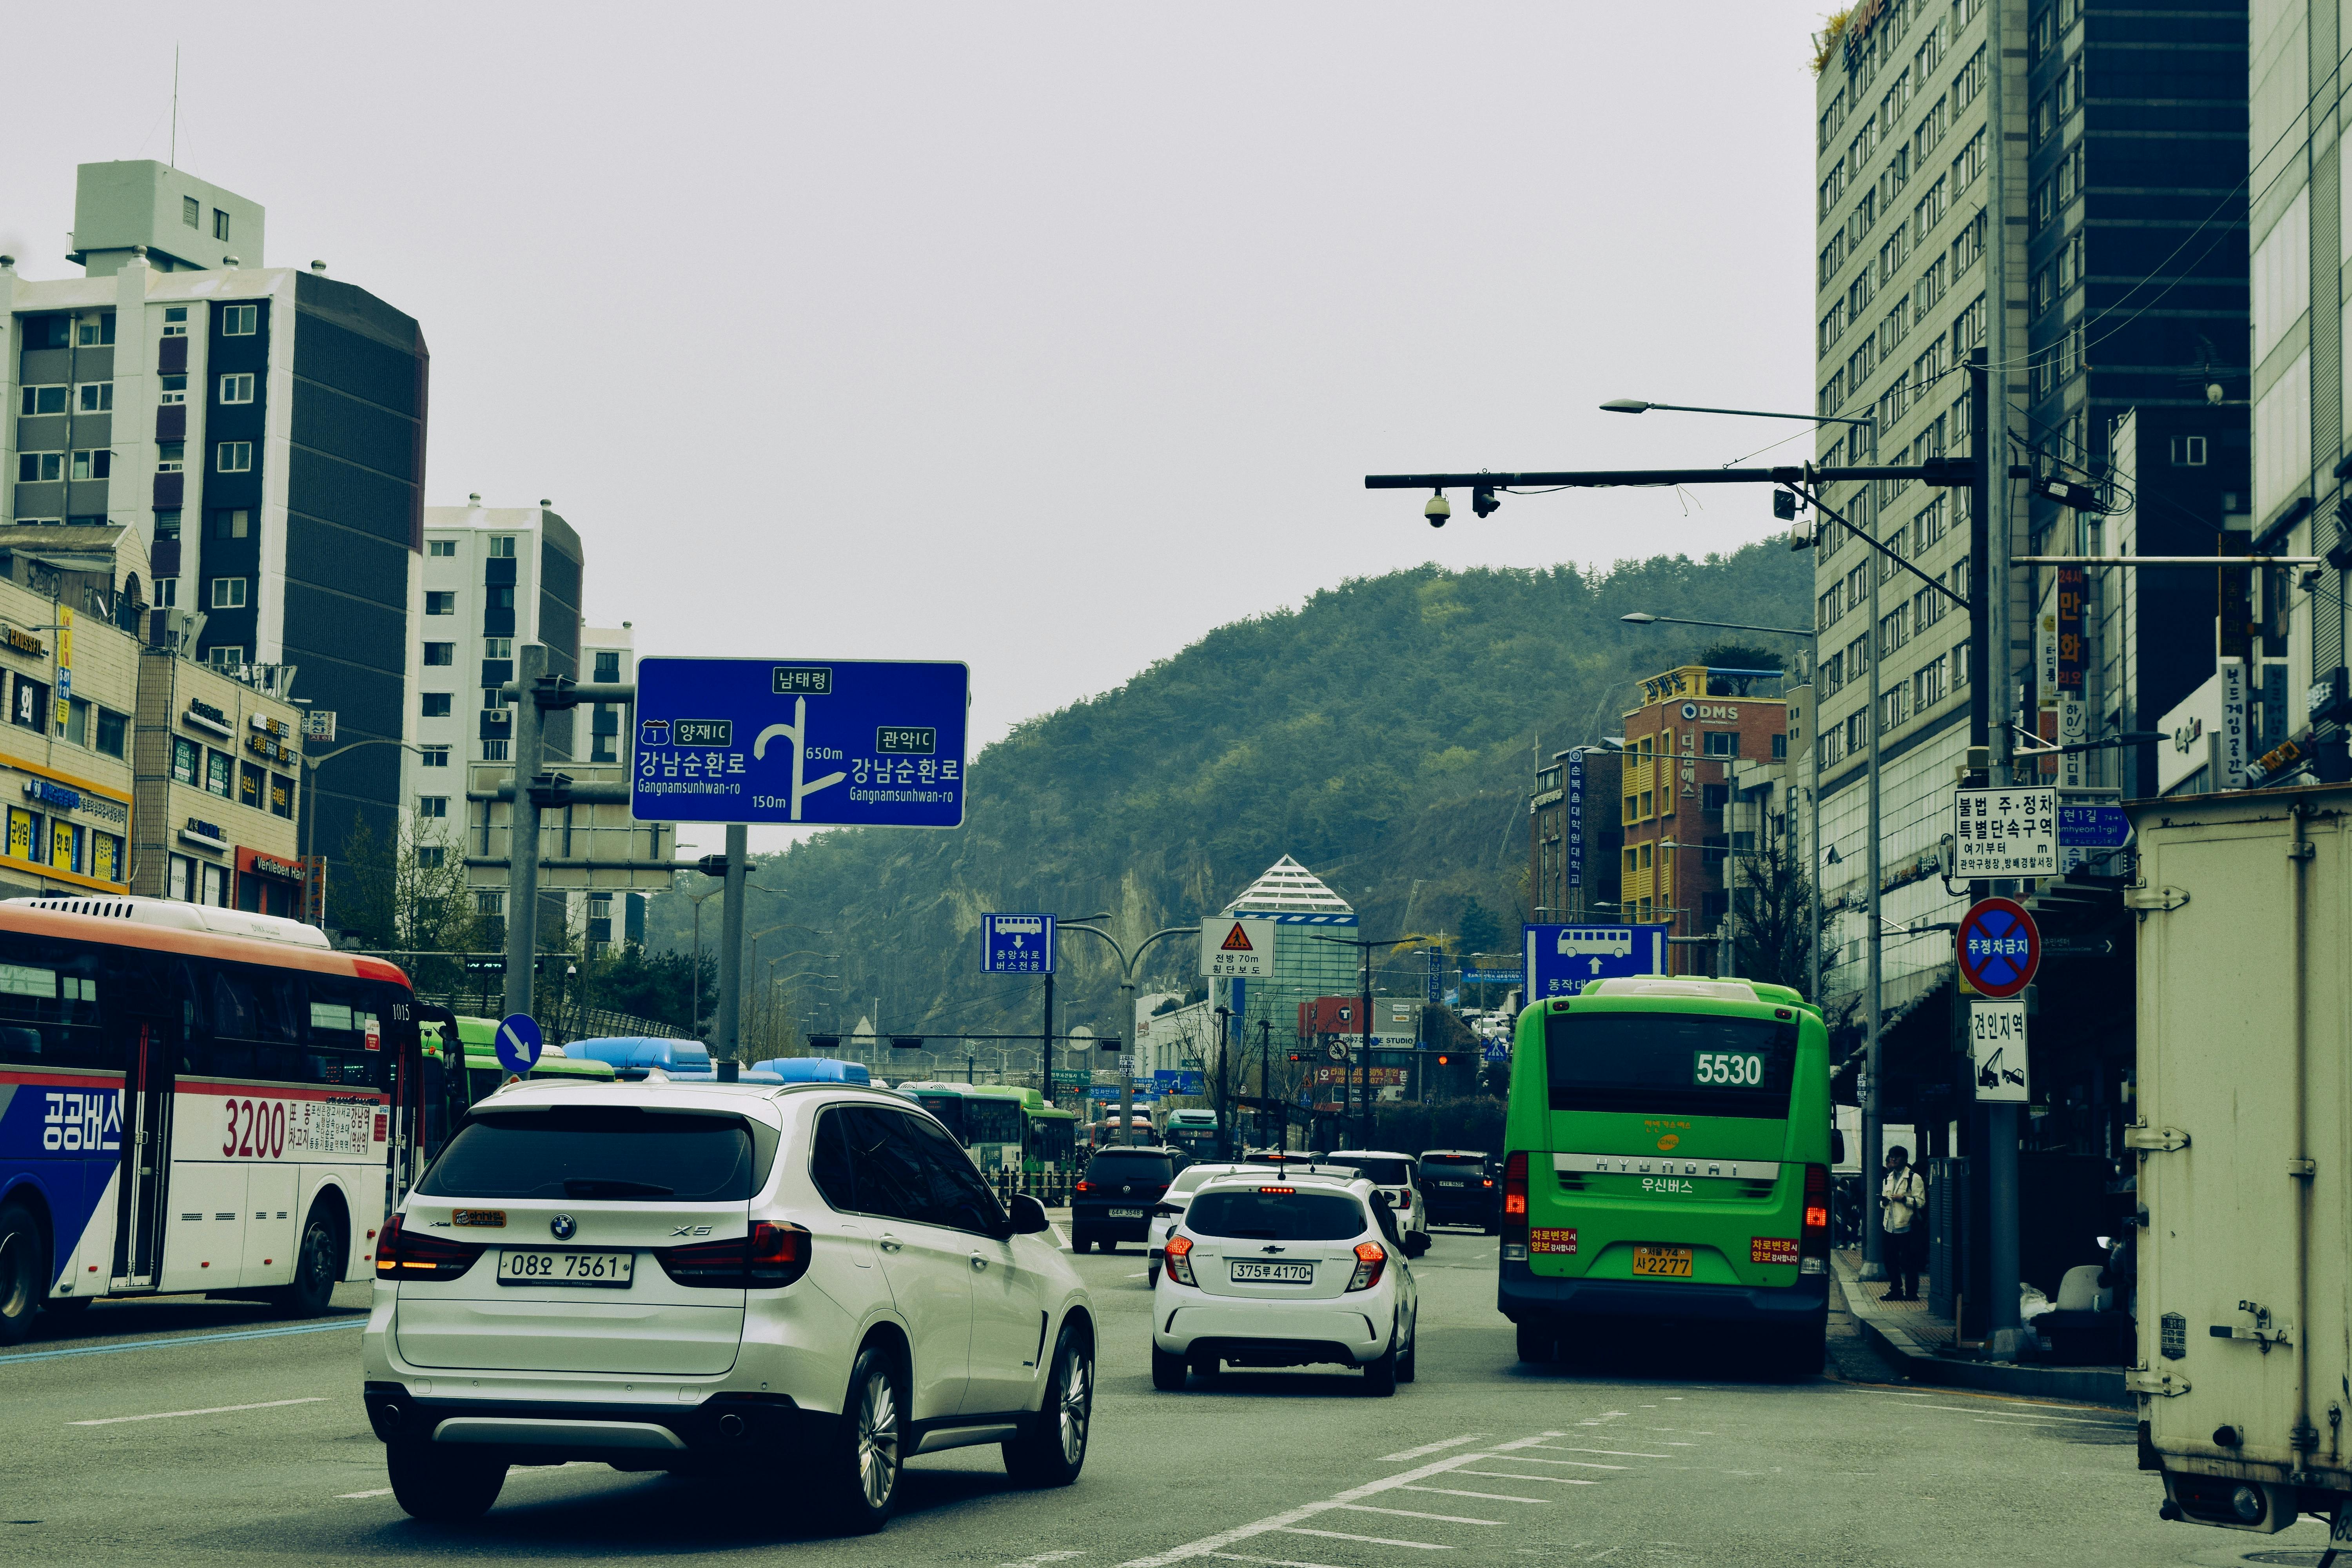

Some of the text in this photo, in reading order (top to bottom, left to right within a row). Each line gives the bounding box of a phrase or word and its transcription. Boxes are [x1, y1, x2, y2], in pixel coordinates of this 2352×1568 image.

[2059, 570, 2082, 583] 24시
[2060, 592, 2081, 662] 만화
[11, 628, 43, 655] CROSSFIT
[780, 671, 826, 690] 남태령
[1646, 673, 1682, 697] DMS
[2059, 671, 2081, 684] 리오
[1700, 706, 1738, 720] DMS
[303, 719, 309, 732] 삼성
[312, 713, 327, 733] 부동산
[2225, 669, 2243, 774] 보드게임공간
[652, 731, 657, 741] 1
[681, 724, 725, 740] 양재IC
[883, 732, 929, 748] 관악IC
[806, 748, 842, 760] 650m
[641, 752, 746, 777] 강남순환로
[852, 759, 959, 784] 강남순환로
[1681, 734, 1695, 797] 디엠에스
[243, 776, 255, 793] 라오스
[638, 779, 740, 795] Gangnamsunhwan-ro
[273, 787, 285, 806] 국제결혼
[753, 796, 786, 808] 150m
[850, 788, 953, 803] Gangnamsunhwan-ro
[1959, 797, 1987, 817] 불법
[2058, 809, 2096, 822] 현1길
[12, 820, 27, 846] 군상담
[1571, 765, 1581, 885] 순복음대학원대학교
[1959, 818, 2052, 840] 특별단속구역
[2098, 825, 2117, 834] 1-gil
[56, 832, 71, 858] 학회
[1964, 842, 2047, 855] 여기부터 m
[258, 856, 305, 881] Verlieben Hair
[1969, 938, 2028, 955] 주정차금지
[996, 951, 1040, 960] 중앙차로
[1216, 954, 1234, 963] 전방
[996, 961, 1040, 971] 버스전용
[1212, 964, 1261, 975] 횡단보도
[1548, 979, 1591, 991] 동작대
[393, 1004, 409, 1020] 1015
[1975, 1013, 2024, 1041] 견인지역
[1320, 1069, 1329, 1081] 오
[1697, 1054, 1761, 1085] 5530
[44, 1093, 122, 1150] 공공버스
[351, 1107, 369, 1129] 강남역
[223, 1098, 285, 1158] 3200
[289, 1128, 309, 1149] 차고지
[1596, 1158, 1737, 1176] HYUNDAI
[1642, 1178, 1693, 1193] 우신버스
[669, 1225, 713, 1236] X5
[1648, 1248, 1678, 1257] 서울 74
[512, 1254, 617, 1277] 08오 7561
[1274, 1266, 1307, 1279] 4170
[1648, 1258, 1690, 1274] 2277
